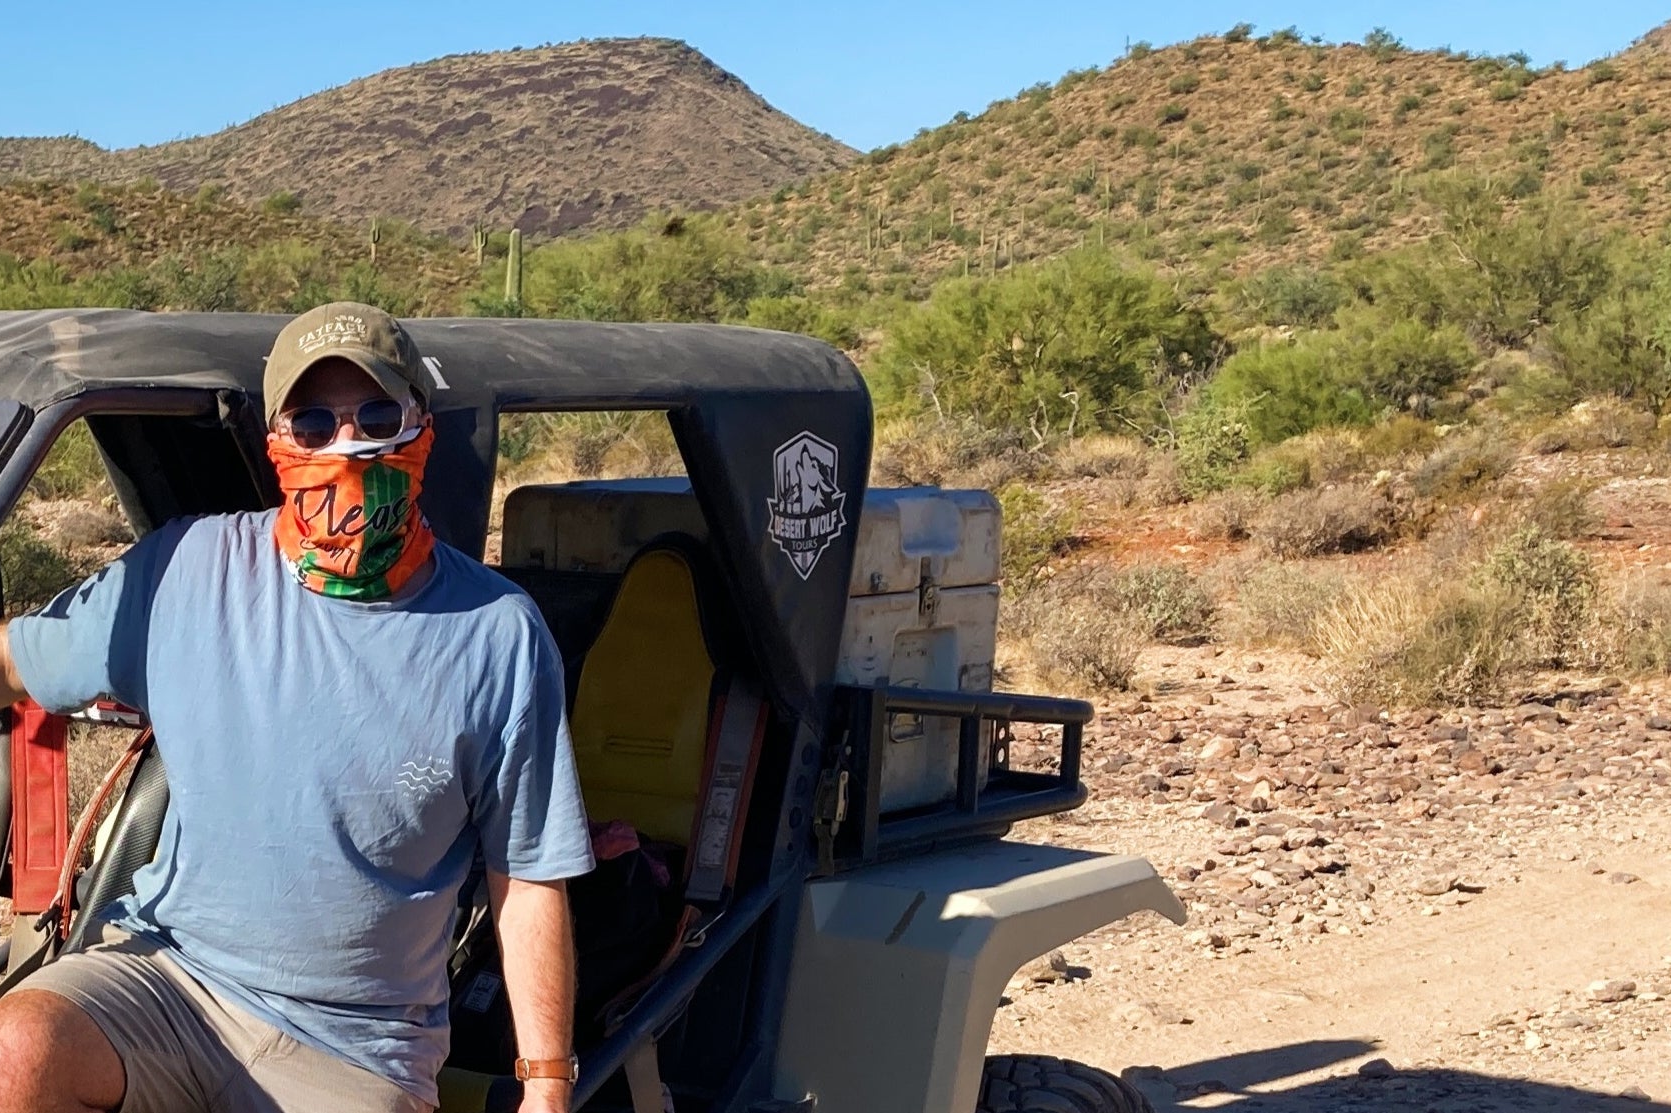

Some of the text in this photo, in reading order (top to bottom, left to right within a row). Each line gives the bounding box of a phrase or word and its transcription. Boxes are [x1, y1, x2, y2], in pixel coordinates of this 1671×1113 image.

[298, 322, 366, 348] FATFACE
[775, 510, 837, 538] DESERT WOLF
[793, 539, 818, 550] TOURS
